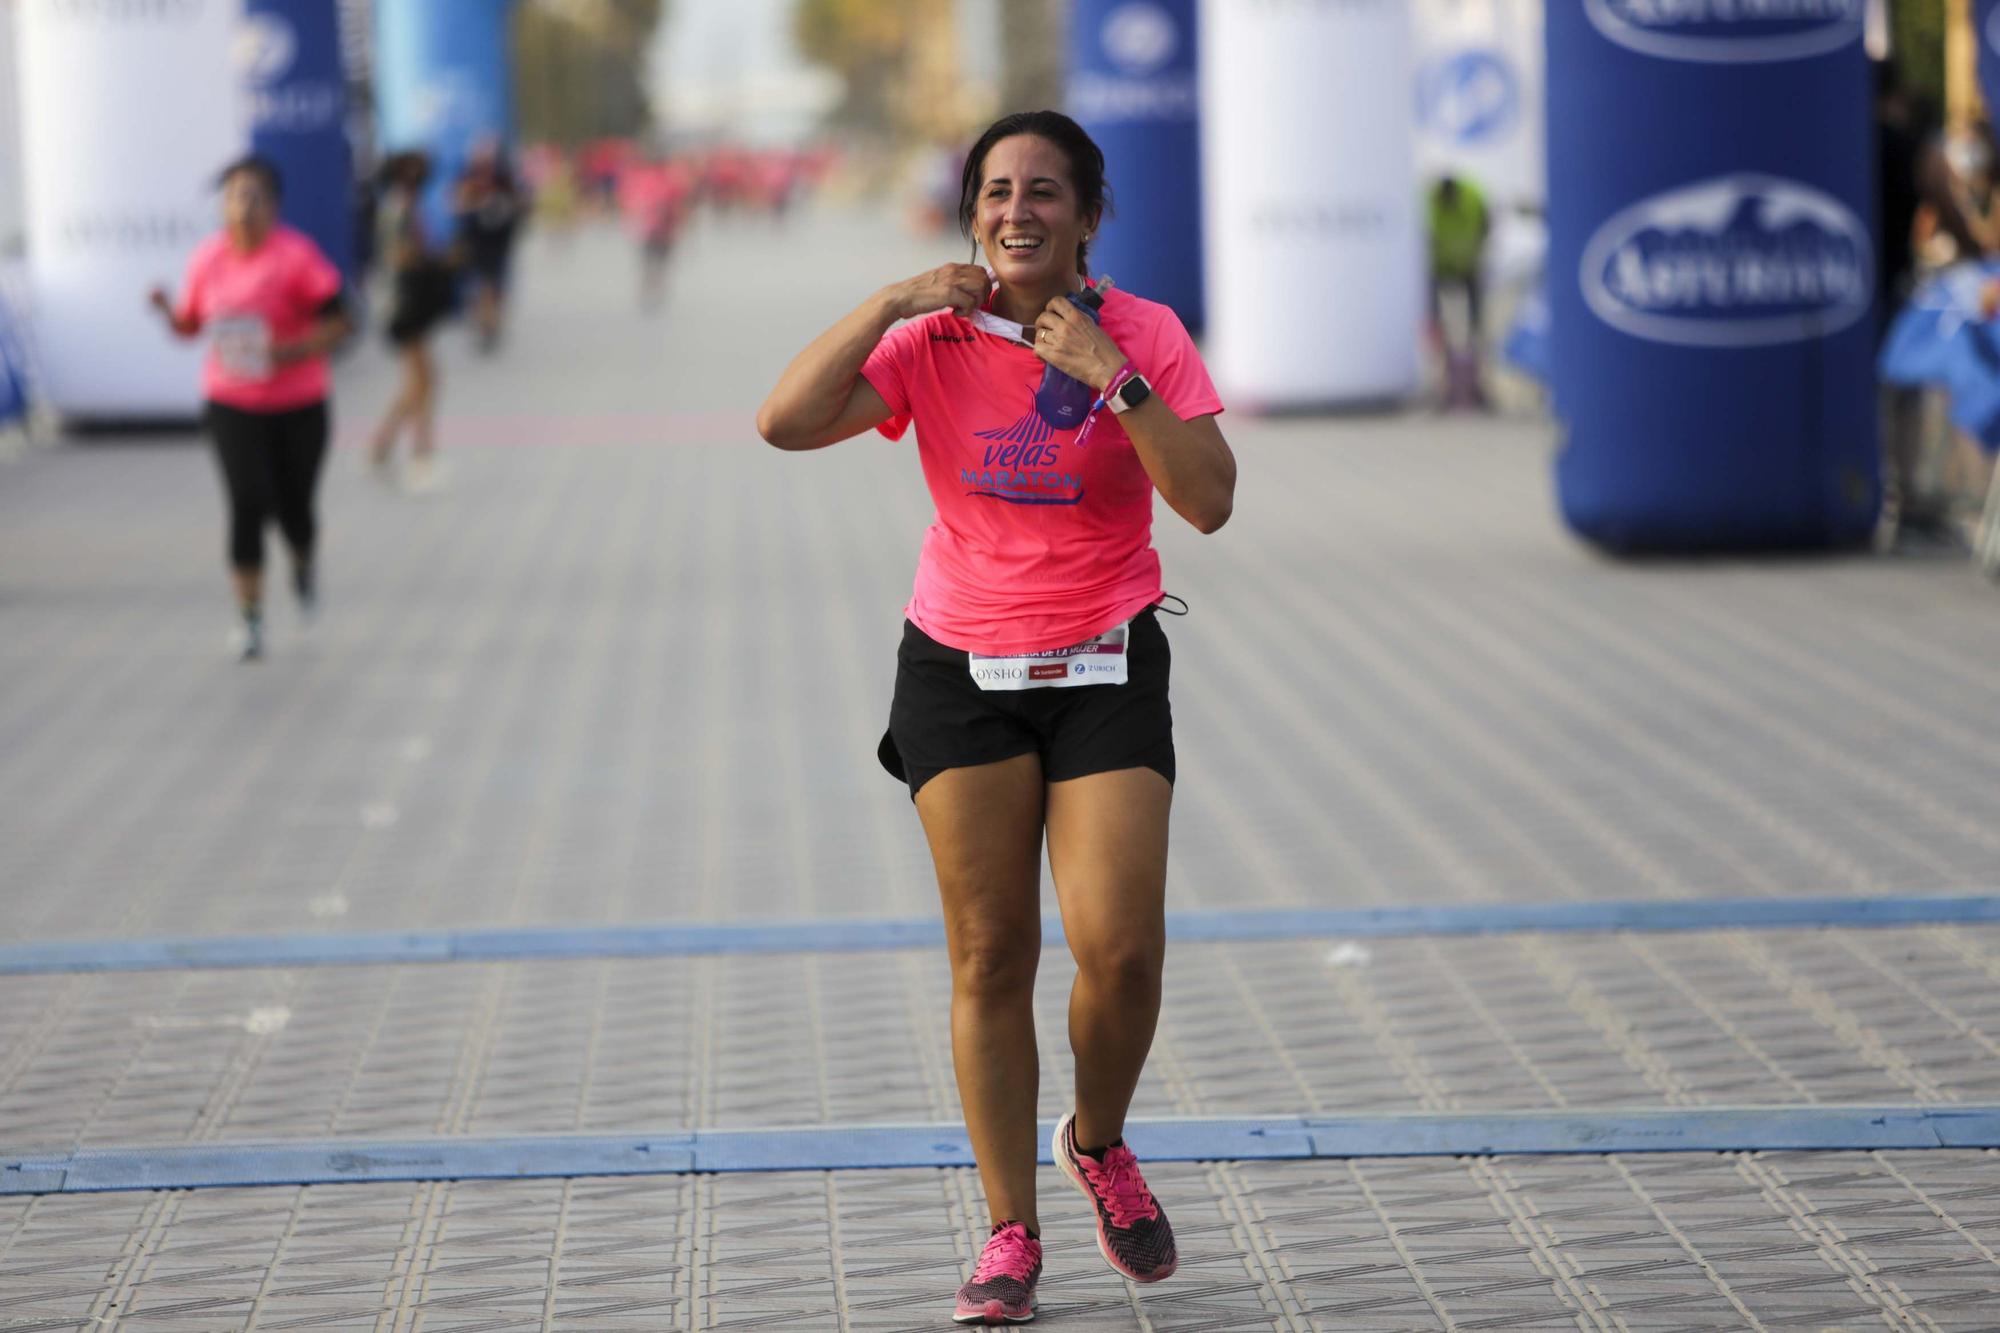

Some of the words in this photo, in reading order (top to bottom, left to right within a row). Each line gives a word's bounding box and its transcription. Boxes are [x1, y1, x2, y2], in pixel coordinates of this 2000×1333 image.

[984, 442, 1061, 472] velas
[961, 468, 1083, 490] MARATON
[1056, 647, 1068, 657] LA
[1069, 644, 1099, 655] MUJER
[976, 668, 1022, 680] OYSHO
